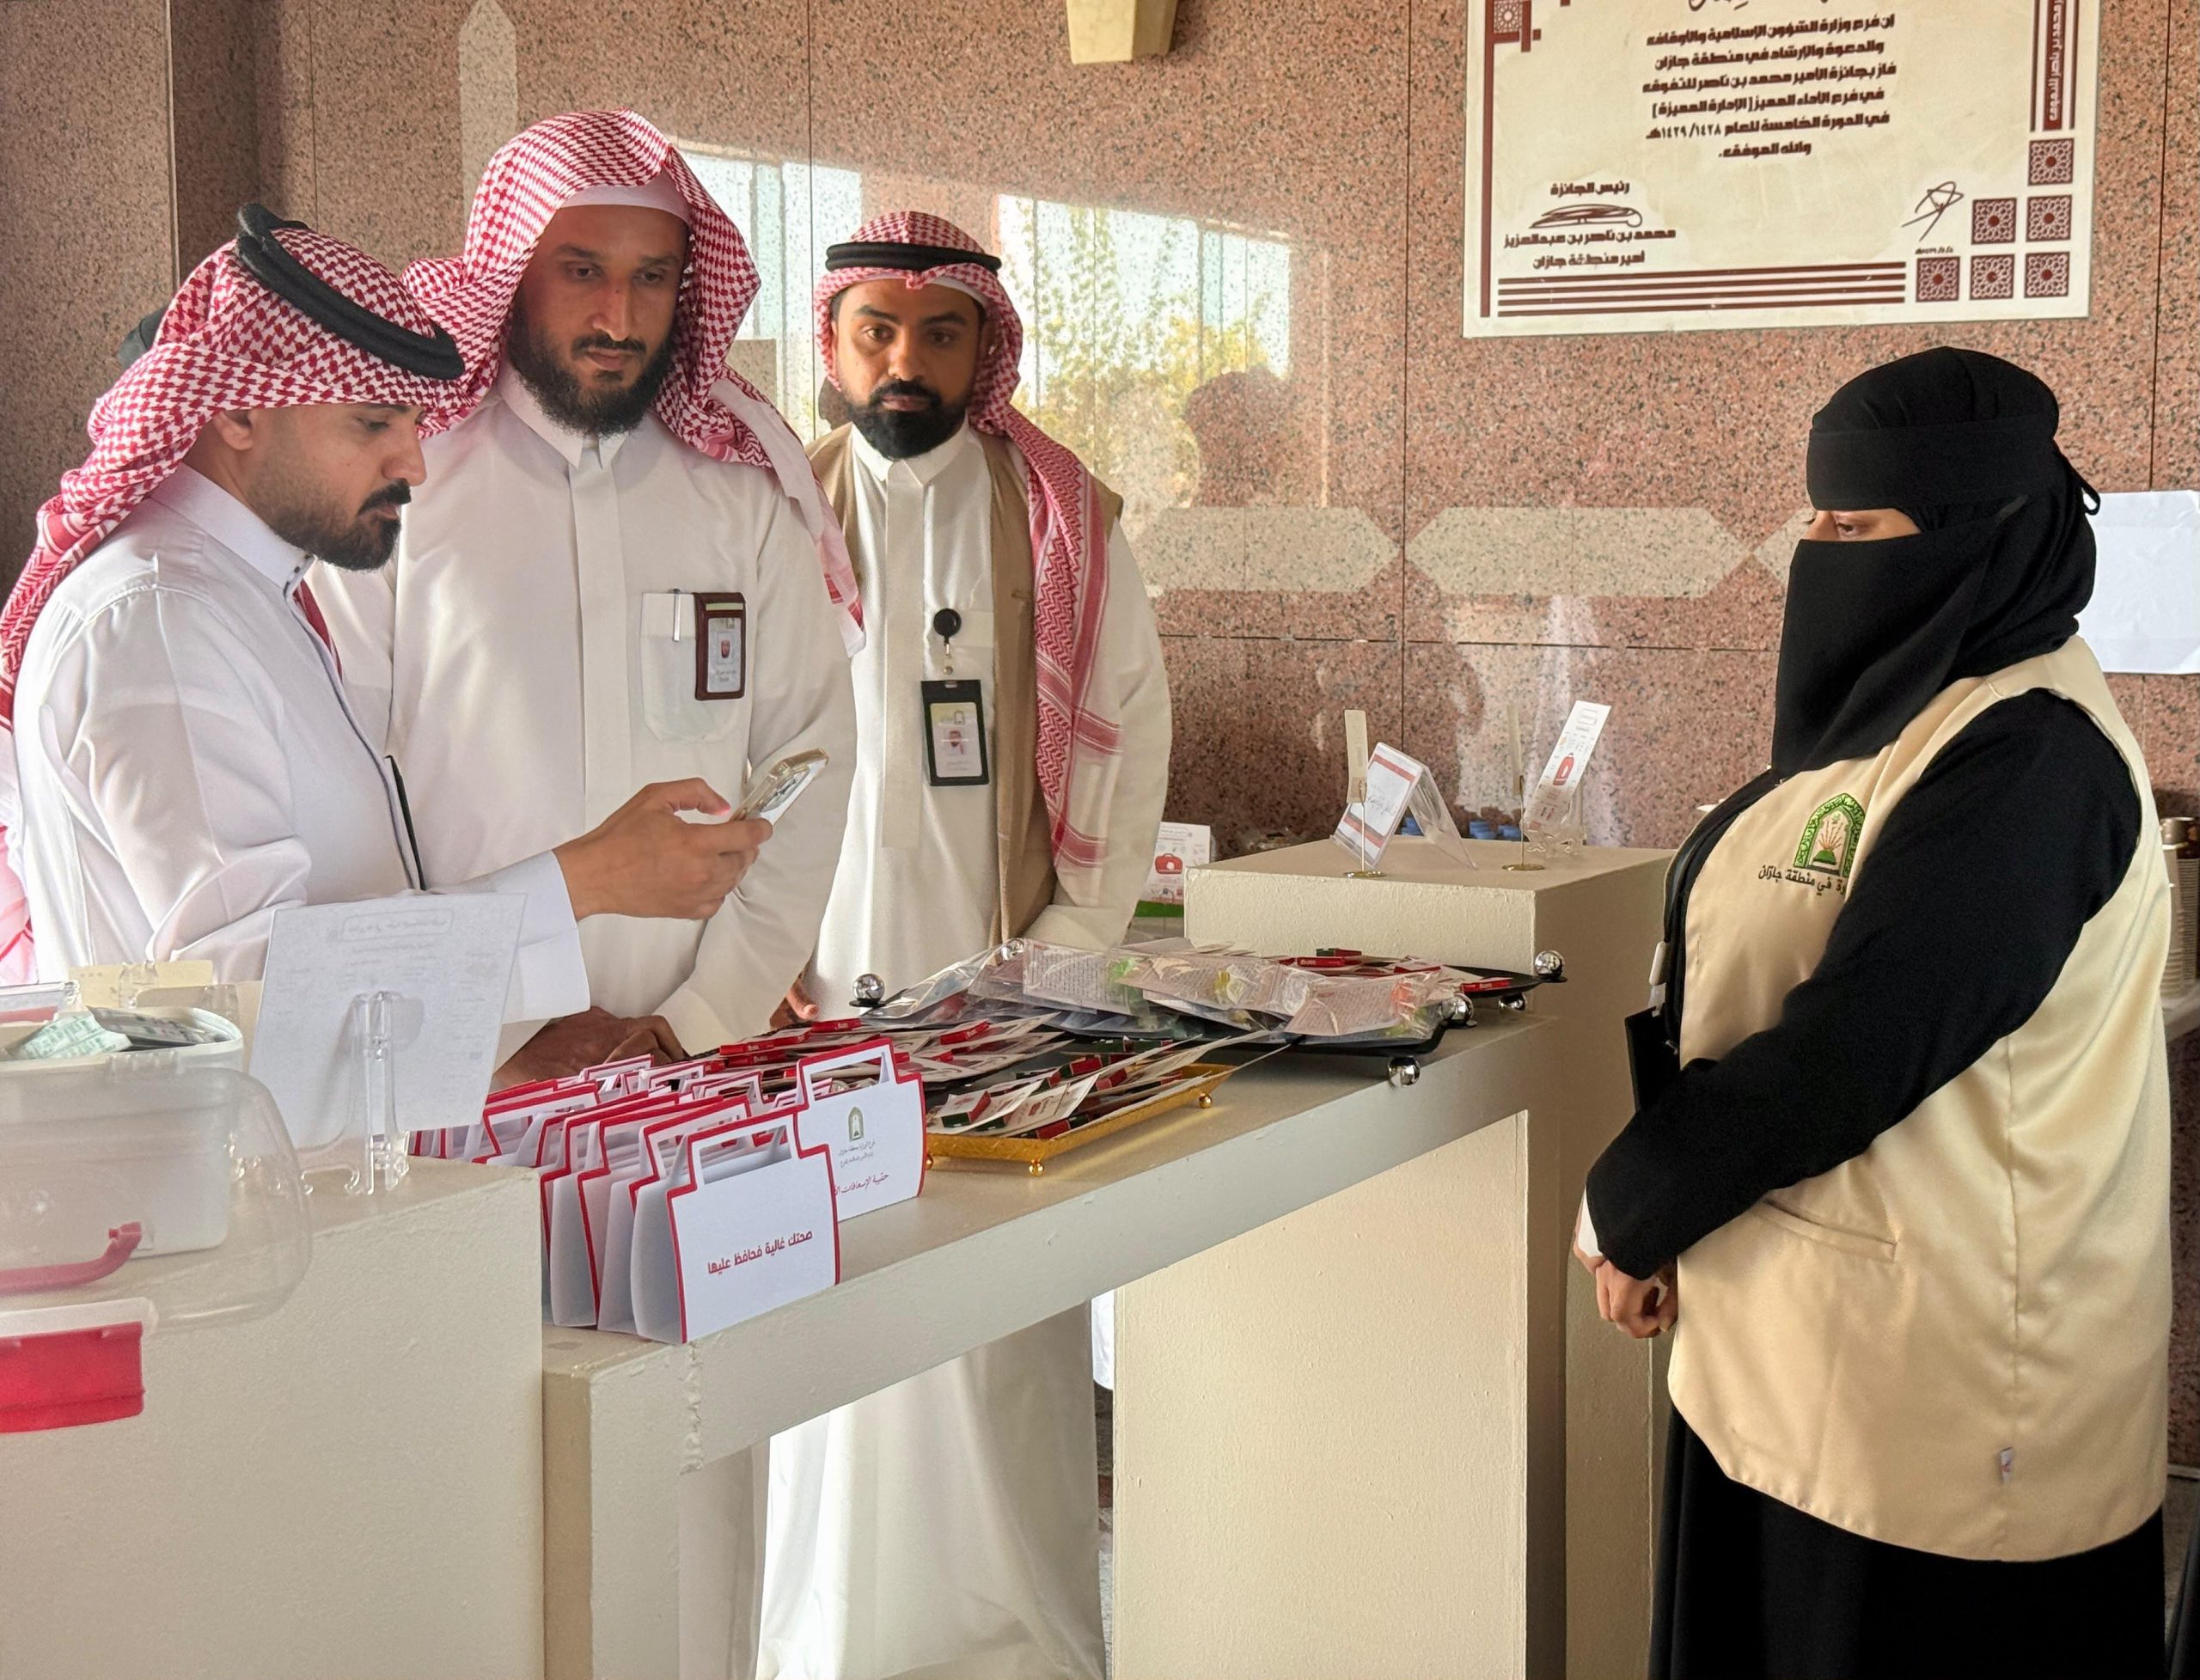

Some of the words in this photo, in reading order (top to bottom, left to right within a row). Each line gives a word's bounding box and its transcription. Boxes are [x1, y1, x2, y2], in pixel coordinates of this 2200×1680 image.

[1767, 20, 1819, 39] الشؤون
[1819, 17, 1851, 34] وزارة
[1852, 14, 1880, 33] فرع
[1646, 29, 1707, 46] والأوقاف
[1708, 23, 1767, 44] الإسلامية
[1745, 46, 1769, 64] في
[1770, 44, 1824, 61] والإرشاد
[1825, 40, 1885, 58] والدعوة
[1654, 54, 1690, 71] جازان
[1691, 50, 1745, 66] منطقة
[1748, 73, 1793, 85] محمد
[1792, 66, 1829, 85] الأمير
[1828, 64, 1876, 82] بجائزة
[1876, 62, 1898, 79] فاز
[1642, 76, 1697, 95] للتفوق
[1696, 74, 1730, 92] ناصر
[1729, 75, 1748, 89] بن
[1754, 95, 1796, 112] المميز
[1796, 90, 1830, 105] الأداء
[1830, 89, 1859, 106] فرع
[1859, 87, 1885, 104] في
[1761, 115, 1821, 132] الخامسة
[1821, 113, 1864, 131] الدورة
[1864, 110, 1891, 128] في
[1724, 120, 1760, 137] للعام
[1780, 141, 1812, 156] والله
[1550, 181, 1595, 198] الجائزة
[1595, 180, 1630, 195] رئيس
[1567, 233, 1585, 246] بن
[1584, 228, 1616, 246] ناصر
[1616, 229, 1634, 243] بن
[1634, 229, 1677, 241] محمد
[1532, 255, 1568, 270] جازان
[1568, 252, 1619, 267] منطقة
[1758, 864, 1783, 883] جازان
[1785, 868, 1816, 887] منطقة
[1816, 877, 1832, 896] في
[787, 1230, 814, 1247] صحتك
[734, 1243, 763, 1267] فحافظ
[765, 1237, 785, 1258] غالية
[707, 1259, 731, 1276] عليها
